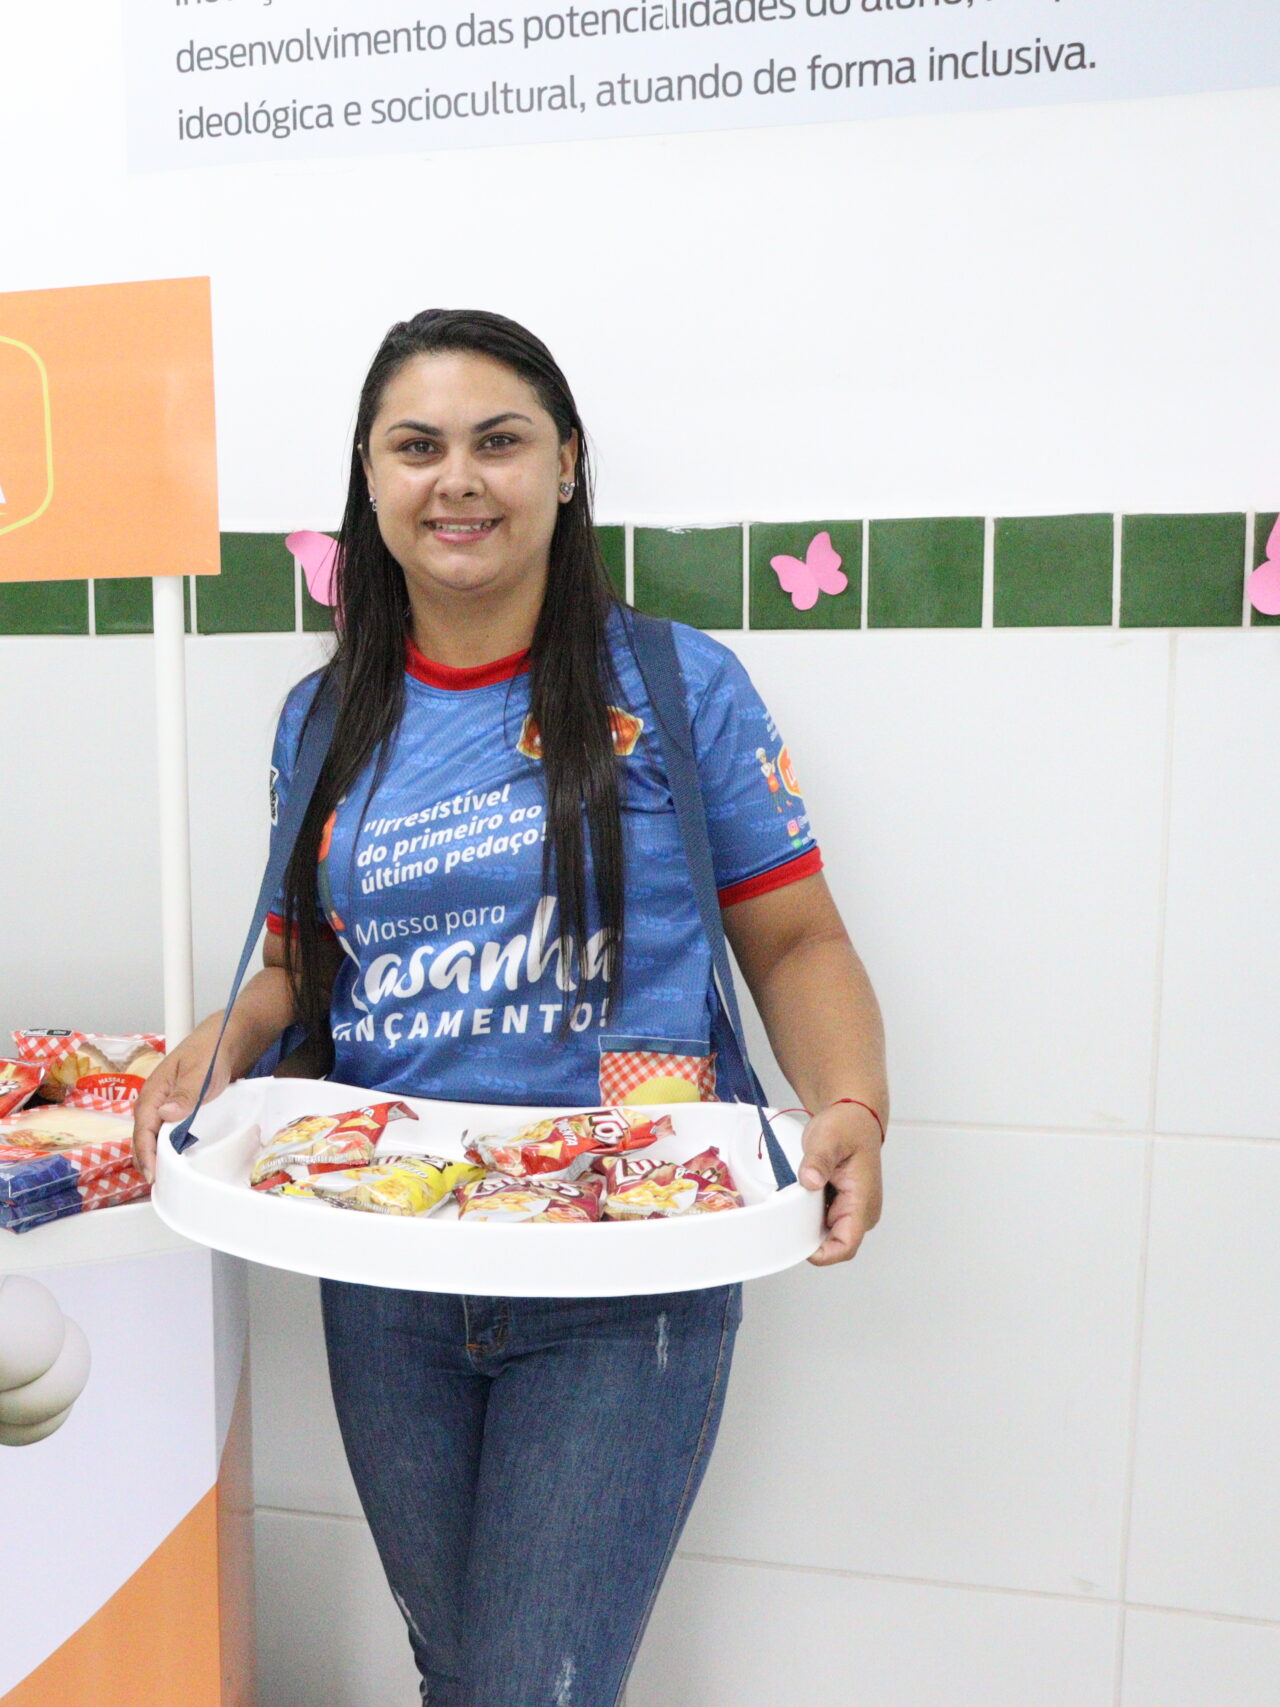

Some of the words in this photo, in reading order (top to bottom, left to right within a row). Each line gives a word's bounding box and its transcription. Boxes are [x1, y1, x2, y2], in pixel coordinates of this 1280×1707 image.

[175, 19, 447, 74] desenvolvimento
[455, 12, 516, 48] das
[522, 0, 796, 49] potencialidades
[178, 99, 334, 140] ideológica
[343, 101, 362, 127] e
[370, 74, 586, 125] sociocultural,
[596, 63, 743, 107] atuando
[753, 58, 797, 96] de
[807, 54, 916, 92] forma
[928, 37, 1097, 83] inclusiva.
[356, 844, 388, 868] do
[391, 813, 503, 862] primeiro
[509, 805, 543, 824] ao
[360, 856, 439, 895] último
[444, 821, 547, 874] pedaço!
[355, 913, 438, 946] Massa
[445, 904, 506, 935] para
